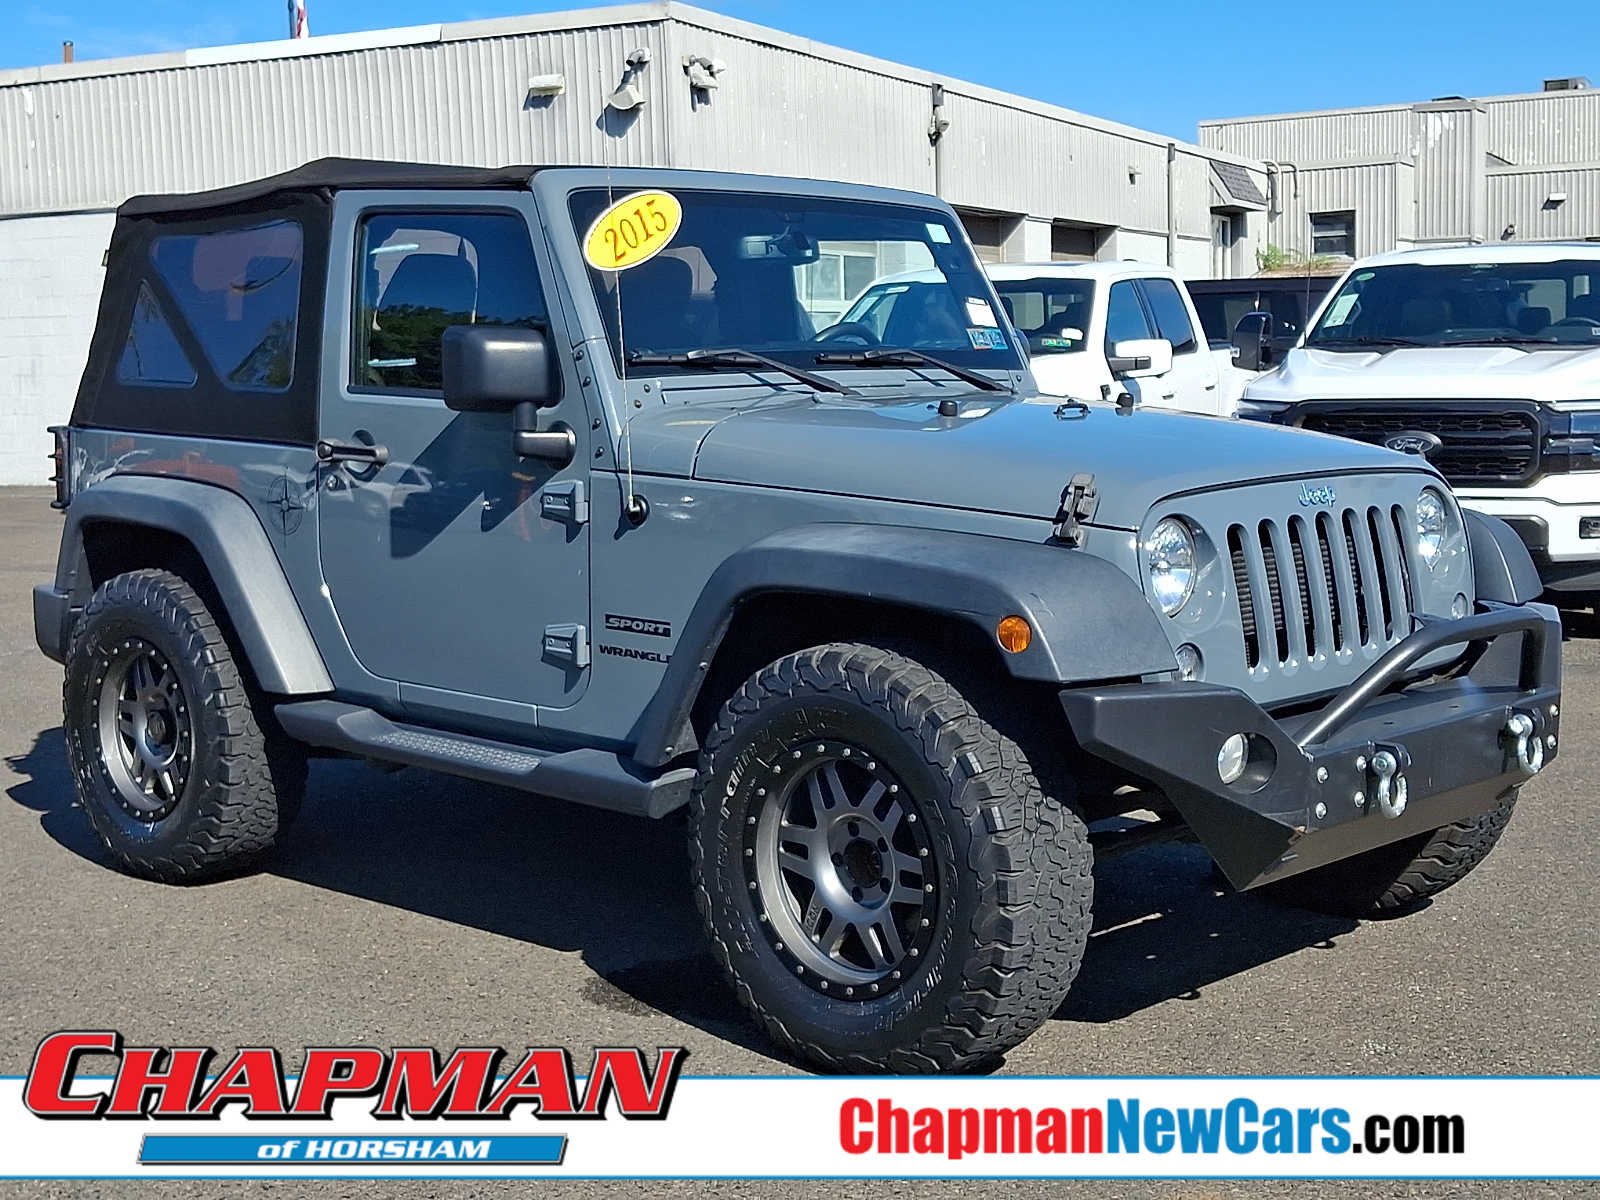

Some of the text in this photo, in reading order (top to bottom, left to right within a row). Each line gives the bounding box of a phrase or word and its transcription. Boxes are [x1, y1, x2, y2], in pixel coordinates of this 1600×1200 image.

[604, 199, 667, 262] 2015
[1393, 437, 1425, 451] Ford
[1298, 482, 1336, 507] Jeep
[605, 616, 672, 635] SPORT
